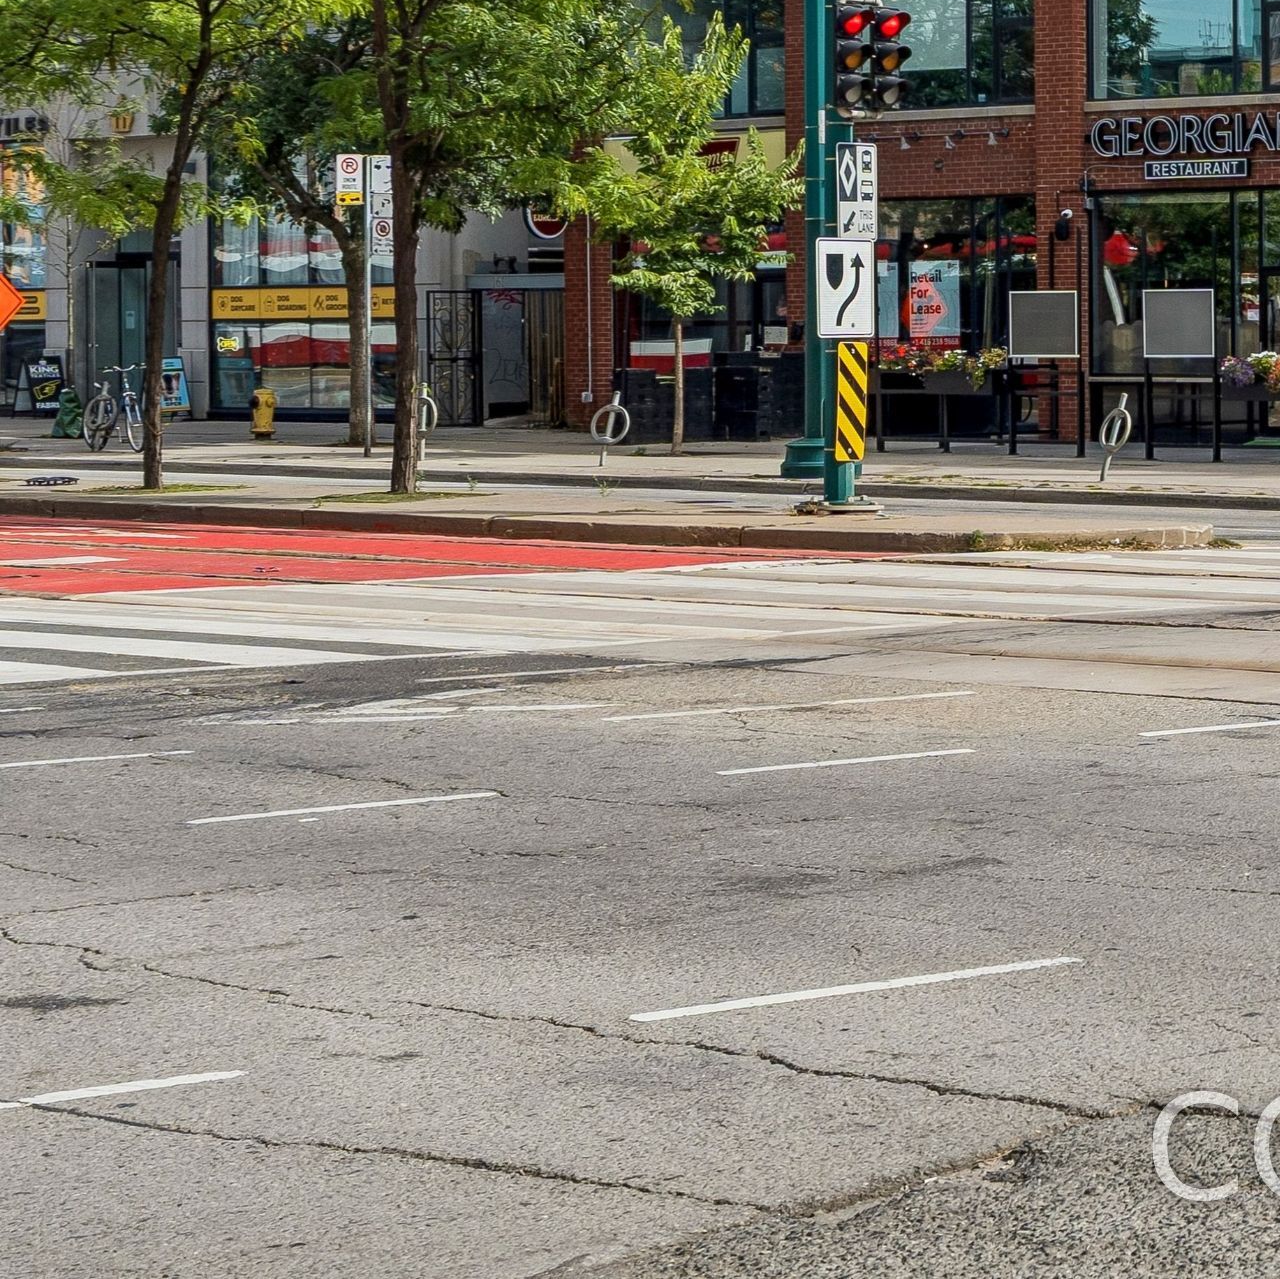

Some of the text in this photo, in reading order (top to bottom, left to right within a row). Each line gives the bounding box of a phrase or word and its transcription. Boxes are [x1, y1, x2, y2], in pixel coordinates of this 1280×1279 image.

[1152, 161, 1239, 177] RESTAURANT
[859, 210, 873, 220] THIS
[858, 223, 874, 233] LANE
[910, 271, 942, 283] Retail
[911, 287, 929, 299] For
[911, 302, 942, 315] Lease
[28, 364, 60, 373] KING
